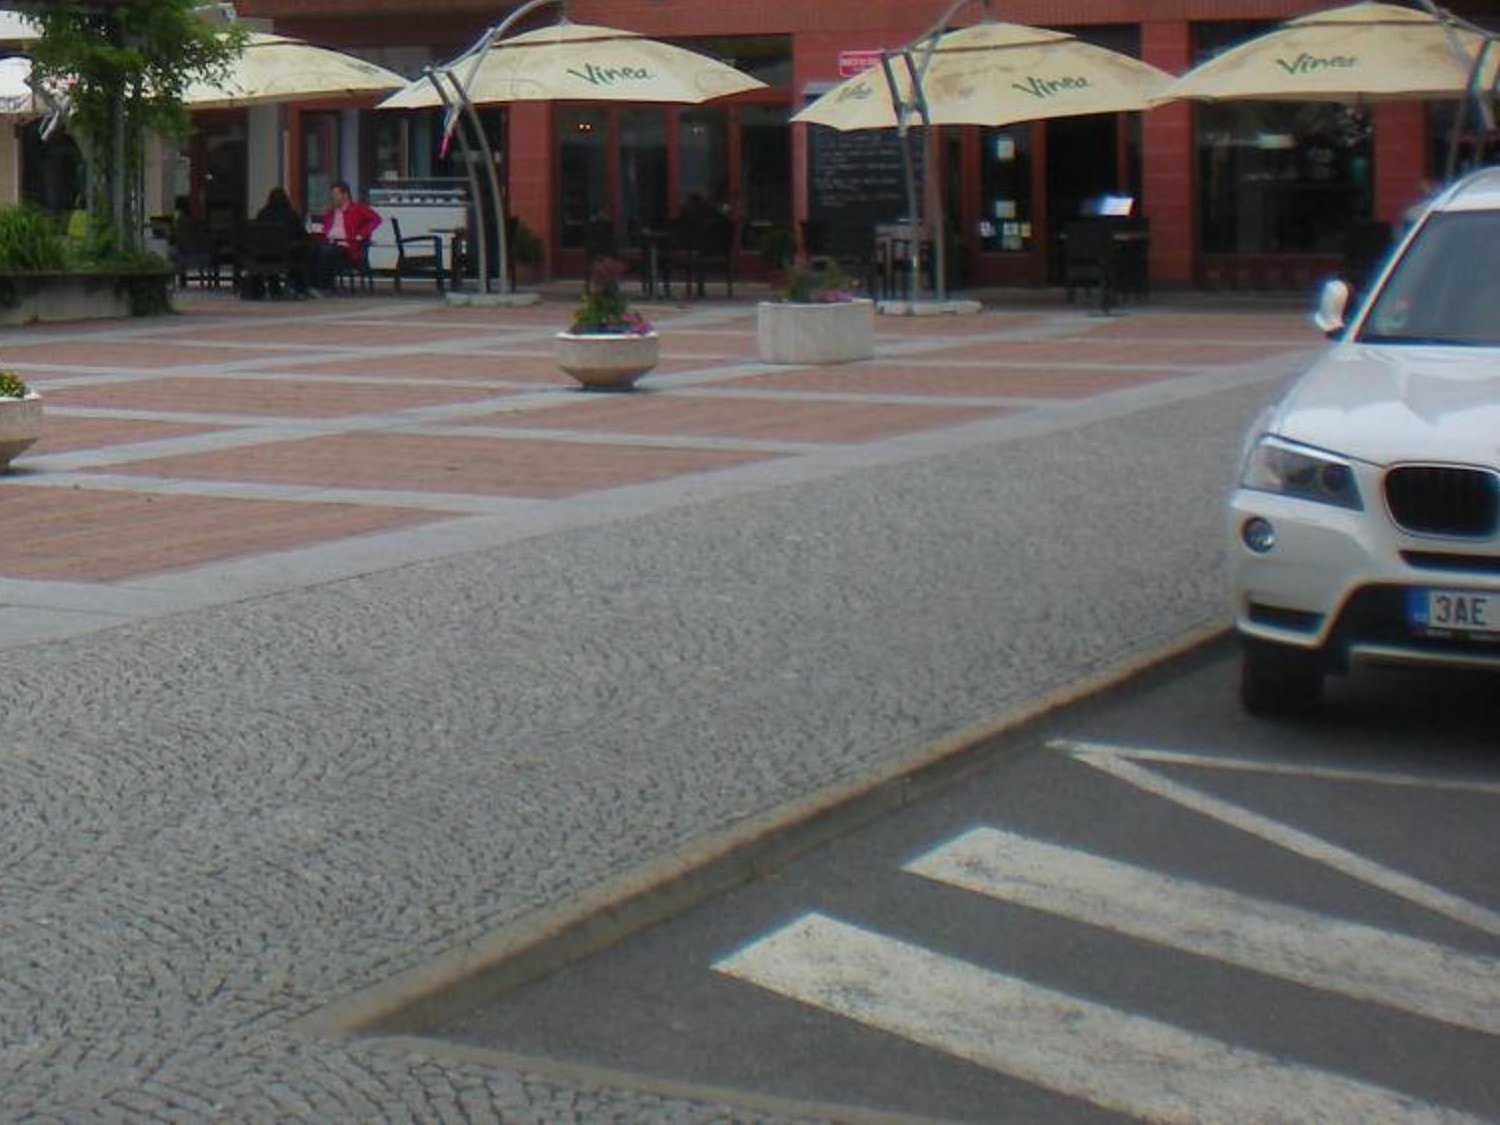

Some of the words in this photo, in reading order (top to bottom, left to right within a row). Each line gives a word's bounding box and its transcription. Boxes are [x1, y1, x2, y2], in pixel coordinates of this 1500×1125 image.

[566, 62, 648, 86] Vinea
[1011, 76, 1092, 98] Vinea
[1435, 596, 1488, 626] 3AE
